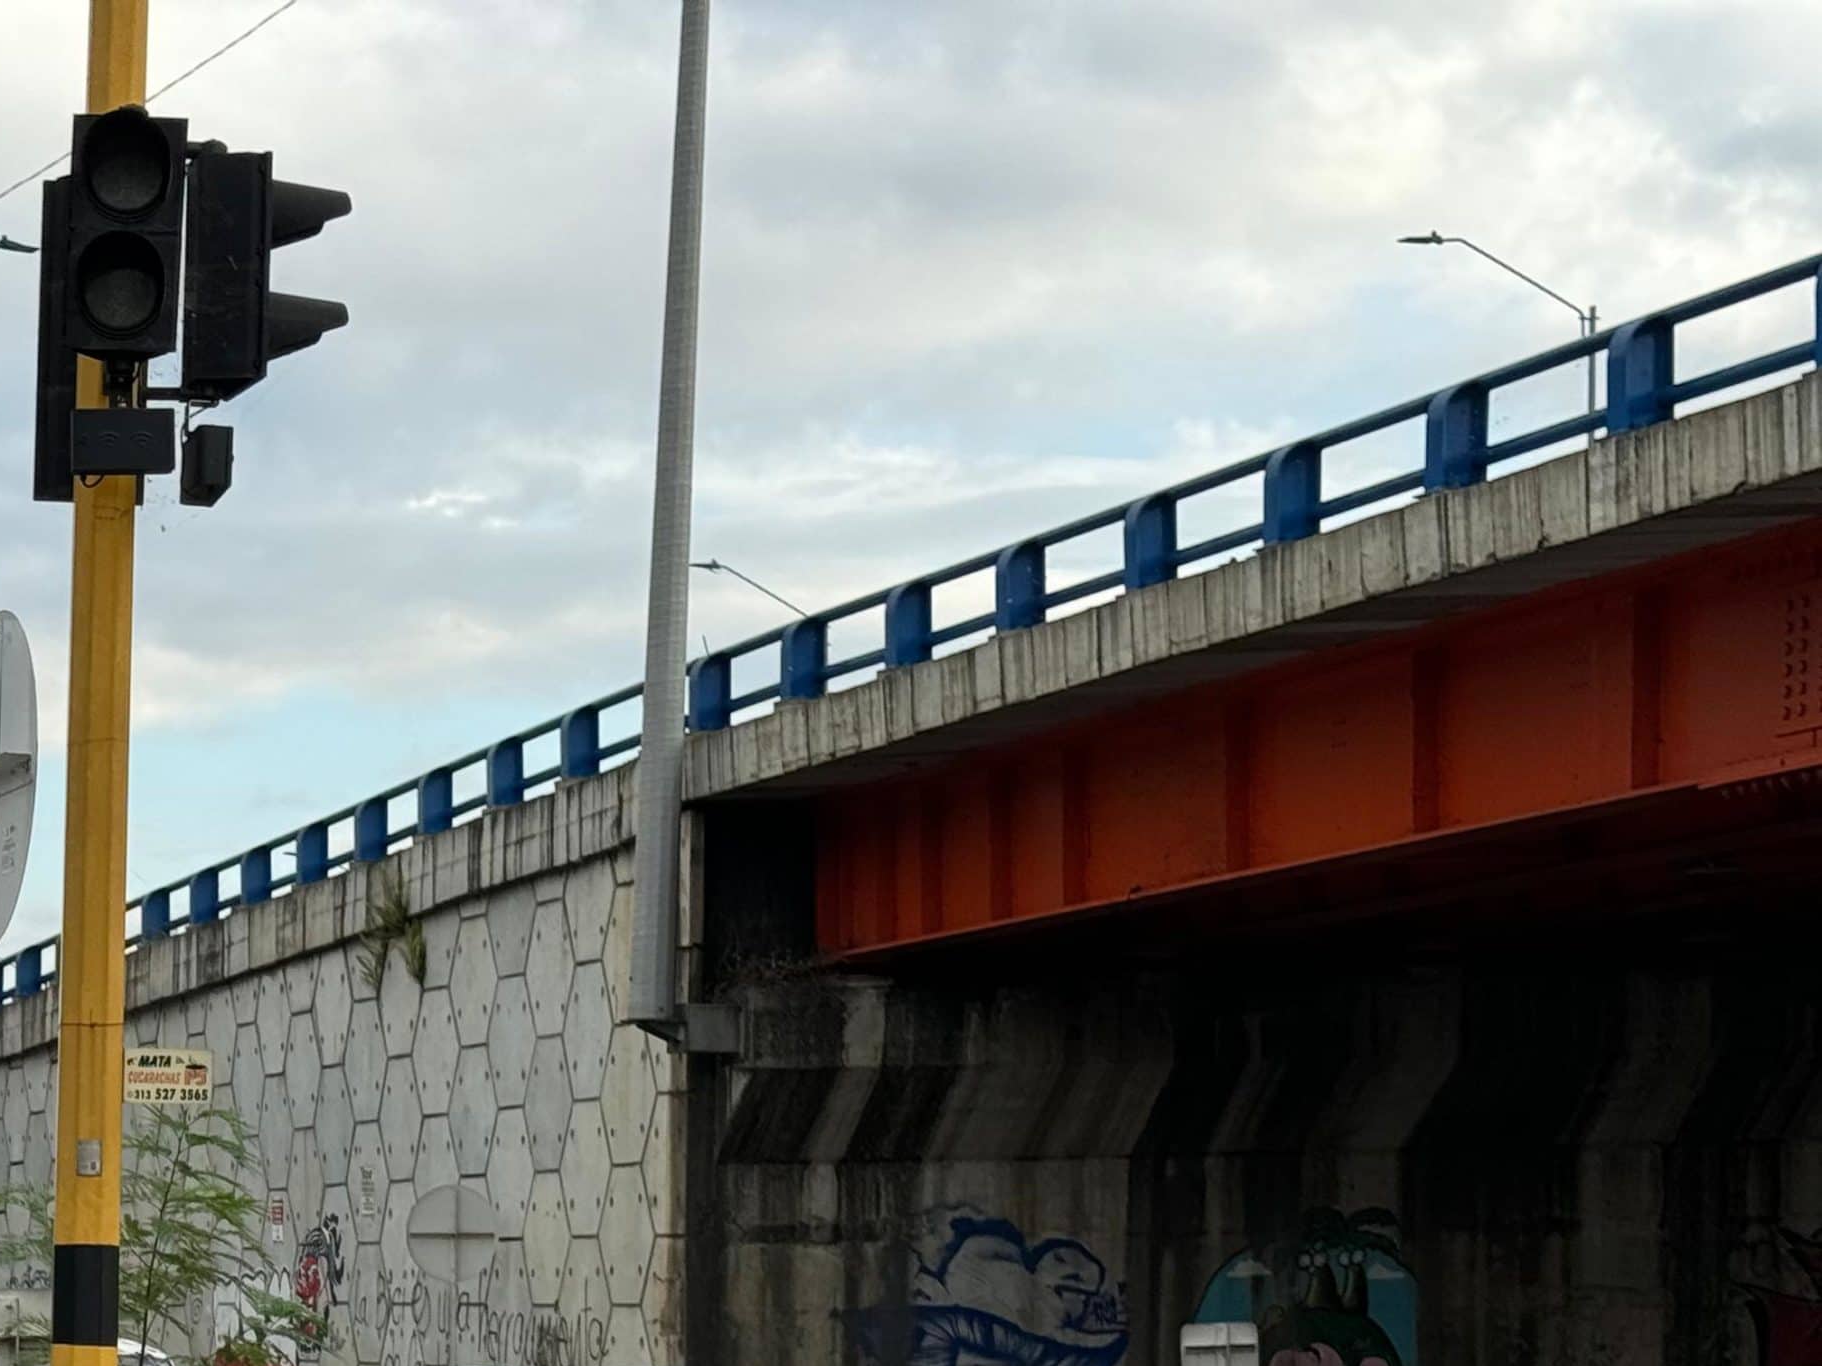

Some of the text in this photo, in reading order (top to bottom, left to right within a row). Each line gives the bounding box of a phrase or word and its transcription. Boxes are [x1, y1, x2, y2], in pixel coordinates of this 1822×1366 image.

[138, 1055, 172, 1067] MATA
[155, 1089, 176, 1100] 527
[180, 1089, 208, 1100] 3565
